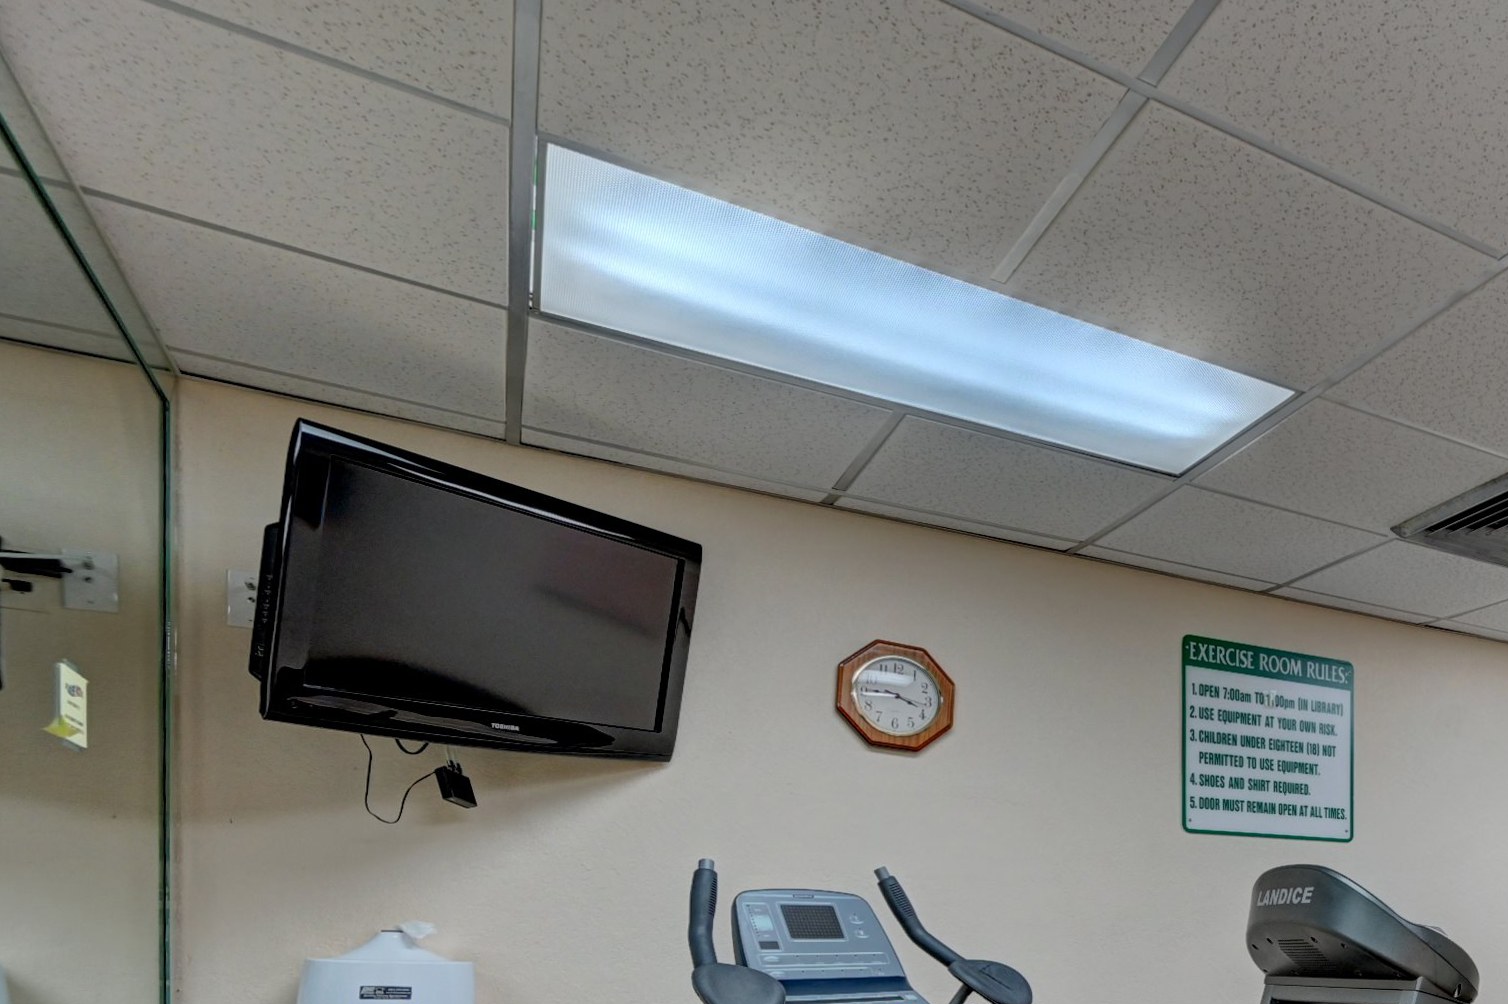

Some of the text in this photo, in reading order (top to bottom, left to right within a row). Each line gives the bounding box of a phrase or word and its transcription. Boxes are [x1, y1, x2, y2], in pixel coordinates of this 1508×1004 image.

[1189, 641, 1255, 669] EXERCISE
[1259, 653, 1302, 677] ROOM
[879, 663, 888, 675] 11
[893, 662, 904, 675] 12
[921, 682, 928, 694] 2
[1192, 682, 1198, 696] 1.
[1199, 684, 1220, 699] OPEN
[1223, 686, 1251, 703] 7:00am
[1254, 691, 1265, 706] TO
[864, 700, 872, 711] 8
[924, 696, 932, 707] 3
[876, 710, 882, 722] 7
[919, 709, 926, 720] 4
[1189, 705, 1338, 737] 2. USE EQUIPMENT AT YOUR OWN RISK.
[891, 717, 899, 729] 6
[907, 717, 915, 728] 5
[1189, 729, 1336, 758] 3. CHILDREN UNDER EIGHTEEN (18) NOT
[1199, 751, 1321, 775] PERMITTED TO USE EQUIPMENT.
[1189, 773, 1311, 796] 4. SHOES AND SHIRT REQUIRED.
[1189, 796, 1347, 820] 5. DOOR MUST REMAIN OPEN AT ALL TIMES.
[1256, 886, 1315, 907] LANDICE
